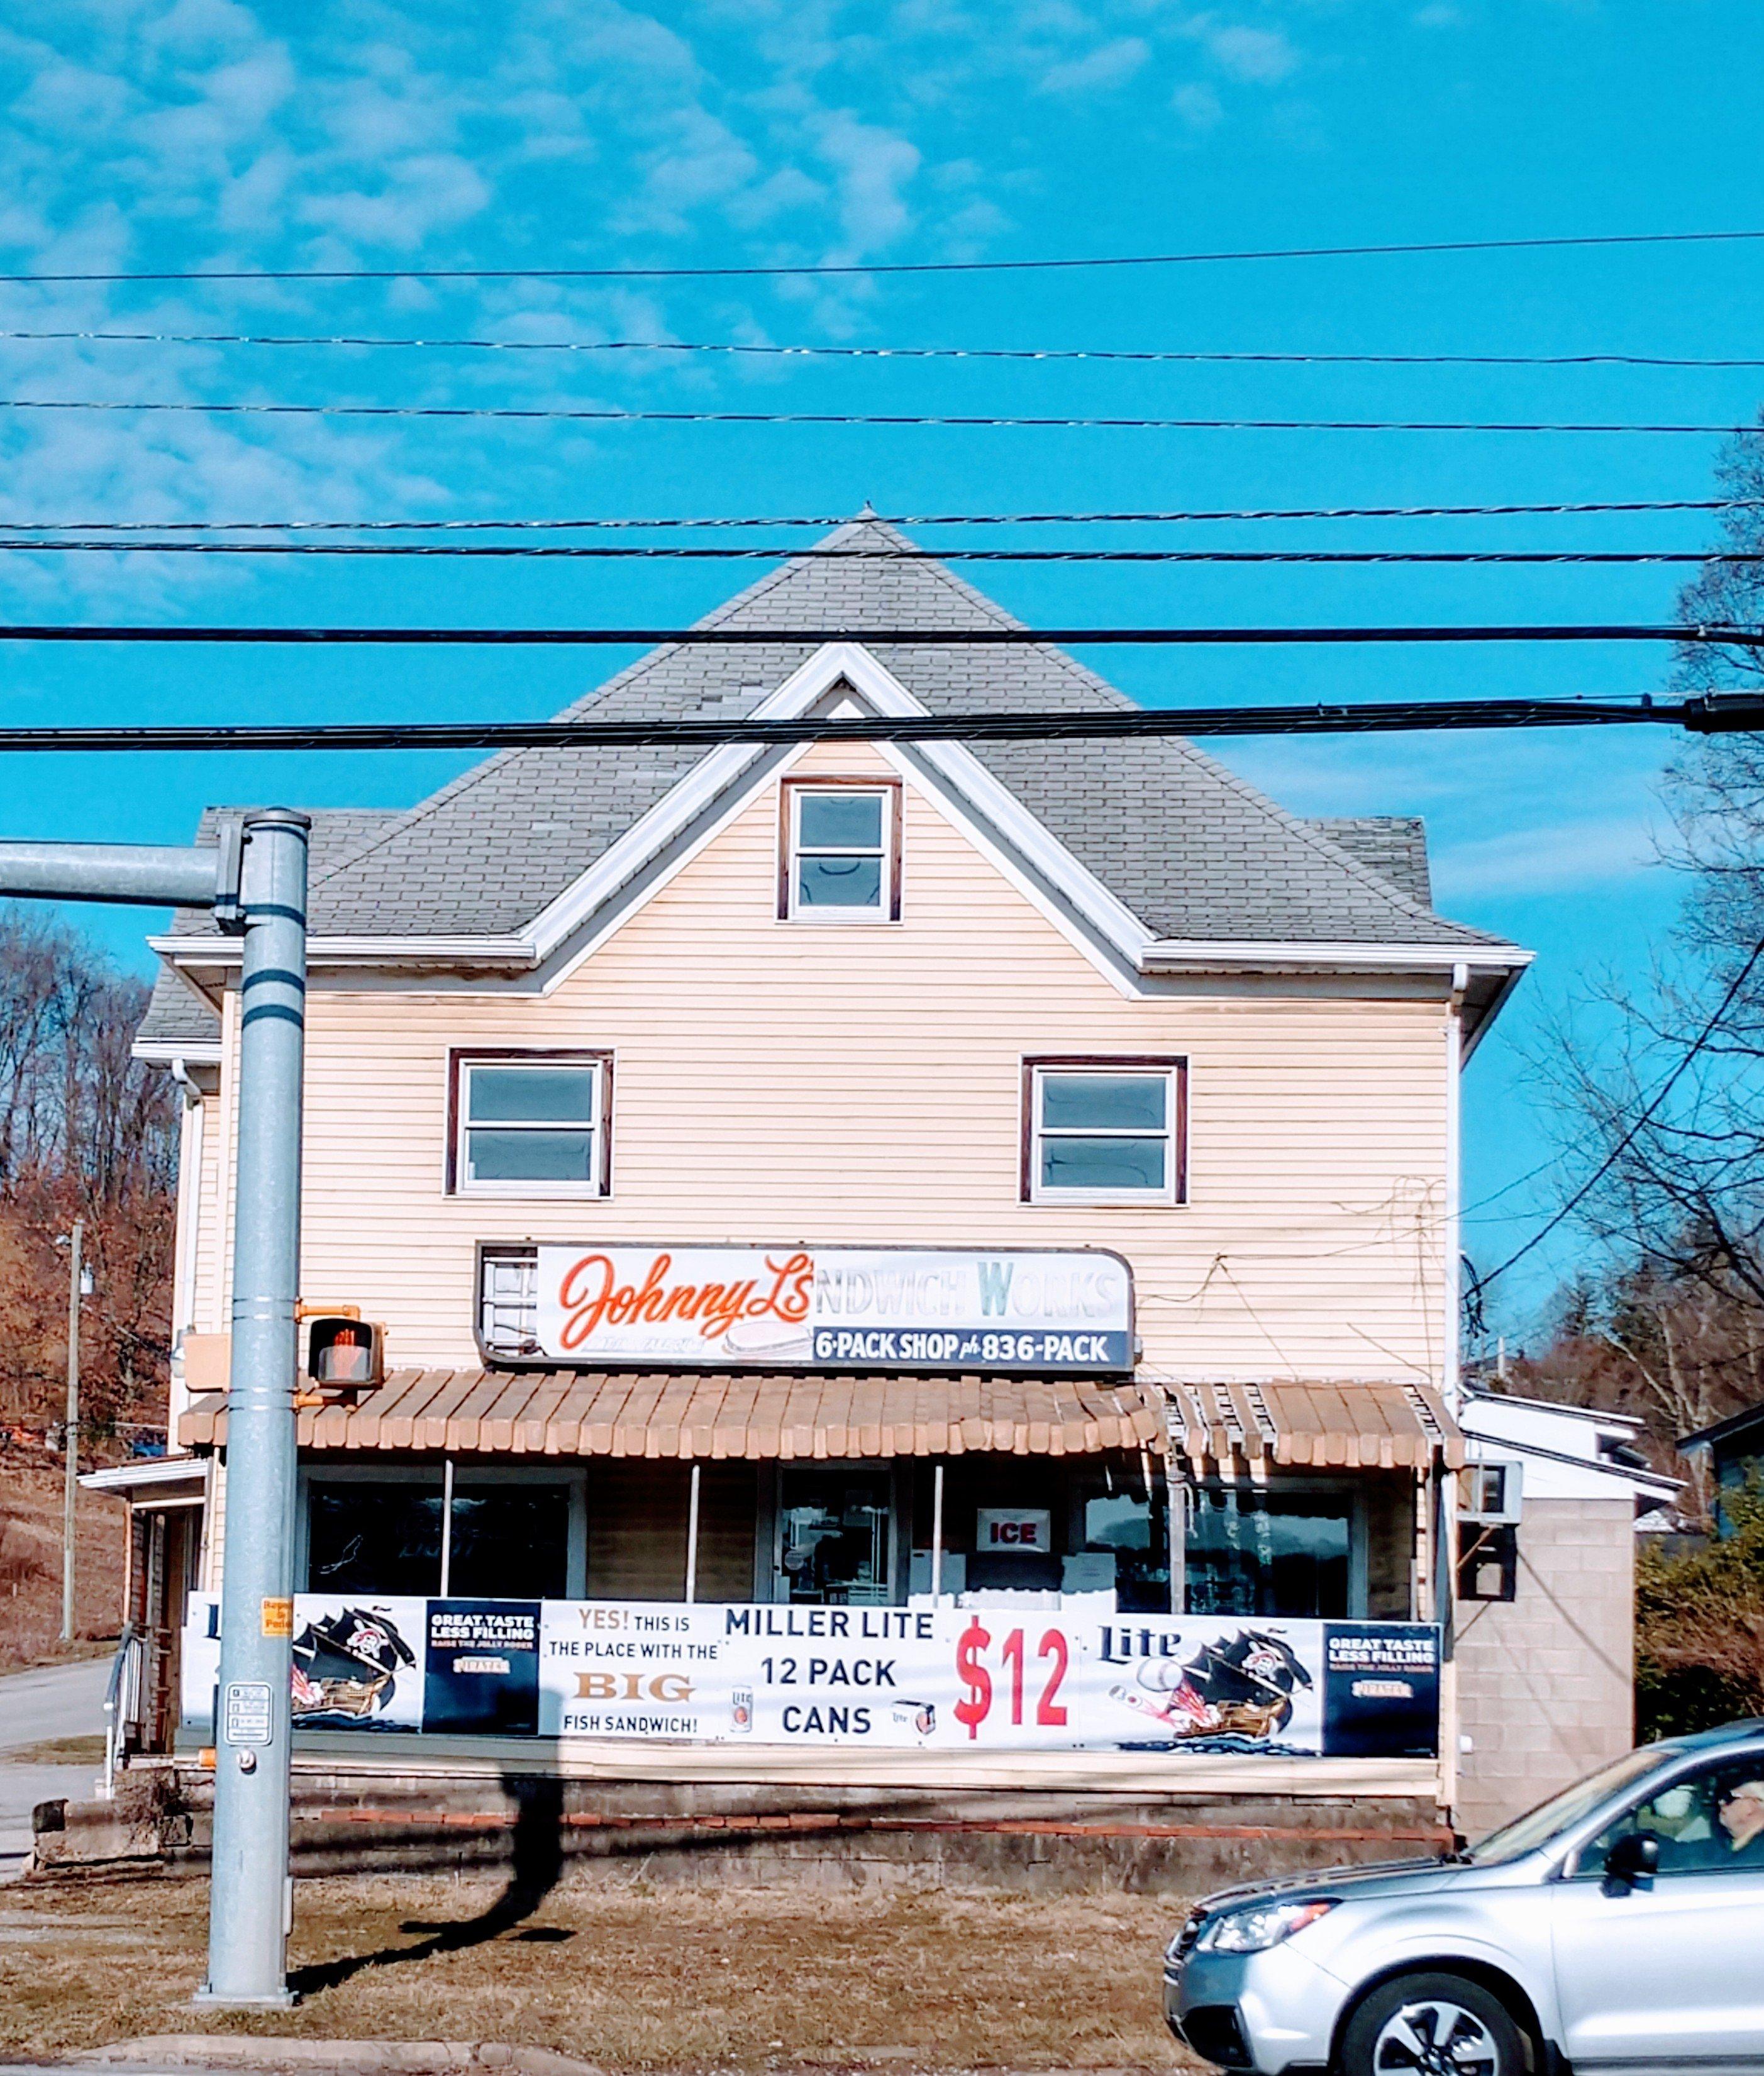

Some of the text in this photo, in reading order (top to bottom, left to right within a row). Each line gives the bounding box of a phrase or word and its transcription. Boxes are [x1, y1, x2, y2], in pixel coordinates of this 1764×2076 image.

[559, 1253, 760, 1350] Johnny
[899, 1333, 959, 1360] SHOP
[982, 1335, 1109, 1362] 836-PACK
[990, 1522, 1037, 1544] ICE
[431, 1614, 535, 1628] GREAT TASTE
[431, 1626, 535, 1640] LESS FILLING
[578, 1607, 691, 1633] YES! THIS IS
[725, 1608, 934, 1640] MILLER LITE
[548, 1641, 718, 1660] THE PLACE WITH THE
[1097, 1625, 1182, 1665] Lite
[1329, 1637, 1434, 1652] GREAT TASTE
[1329, 1649, 1435, 1663] LESS FILLING
[760, 1657, 897, 1687] 12 PACK
[954, 1614, 1068, 1740] $12
[572, 1672, 697, 1702] BIG
[563, 1714, 698, 1734] FISH SANDWICH!
[782, 1705, 872, 1735] CANS
